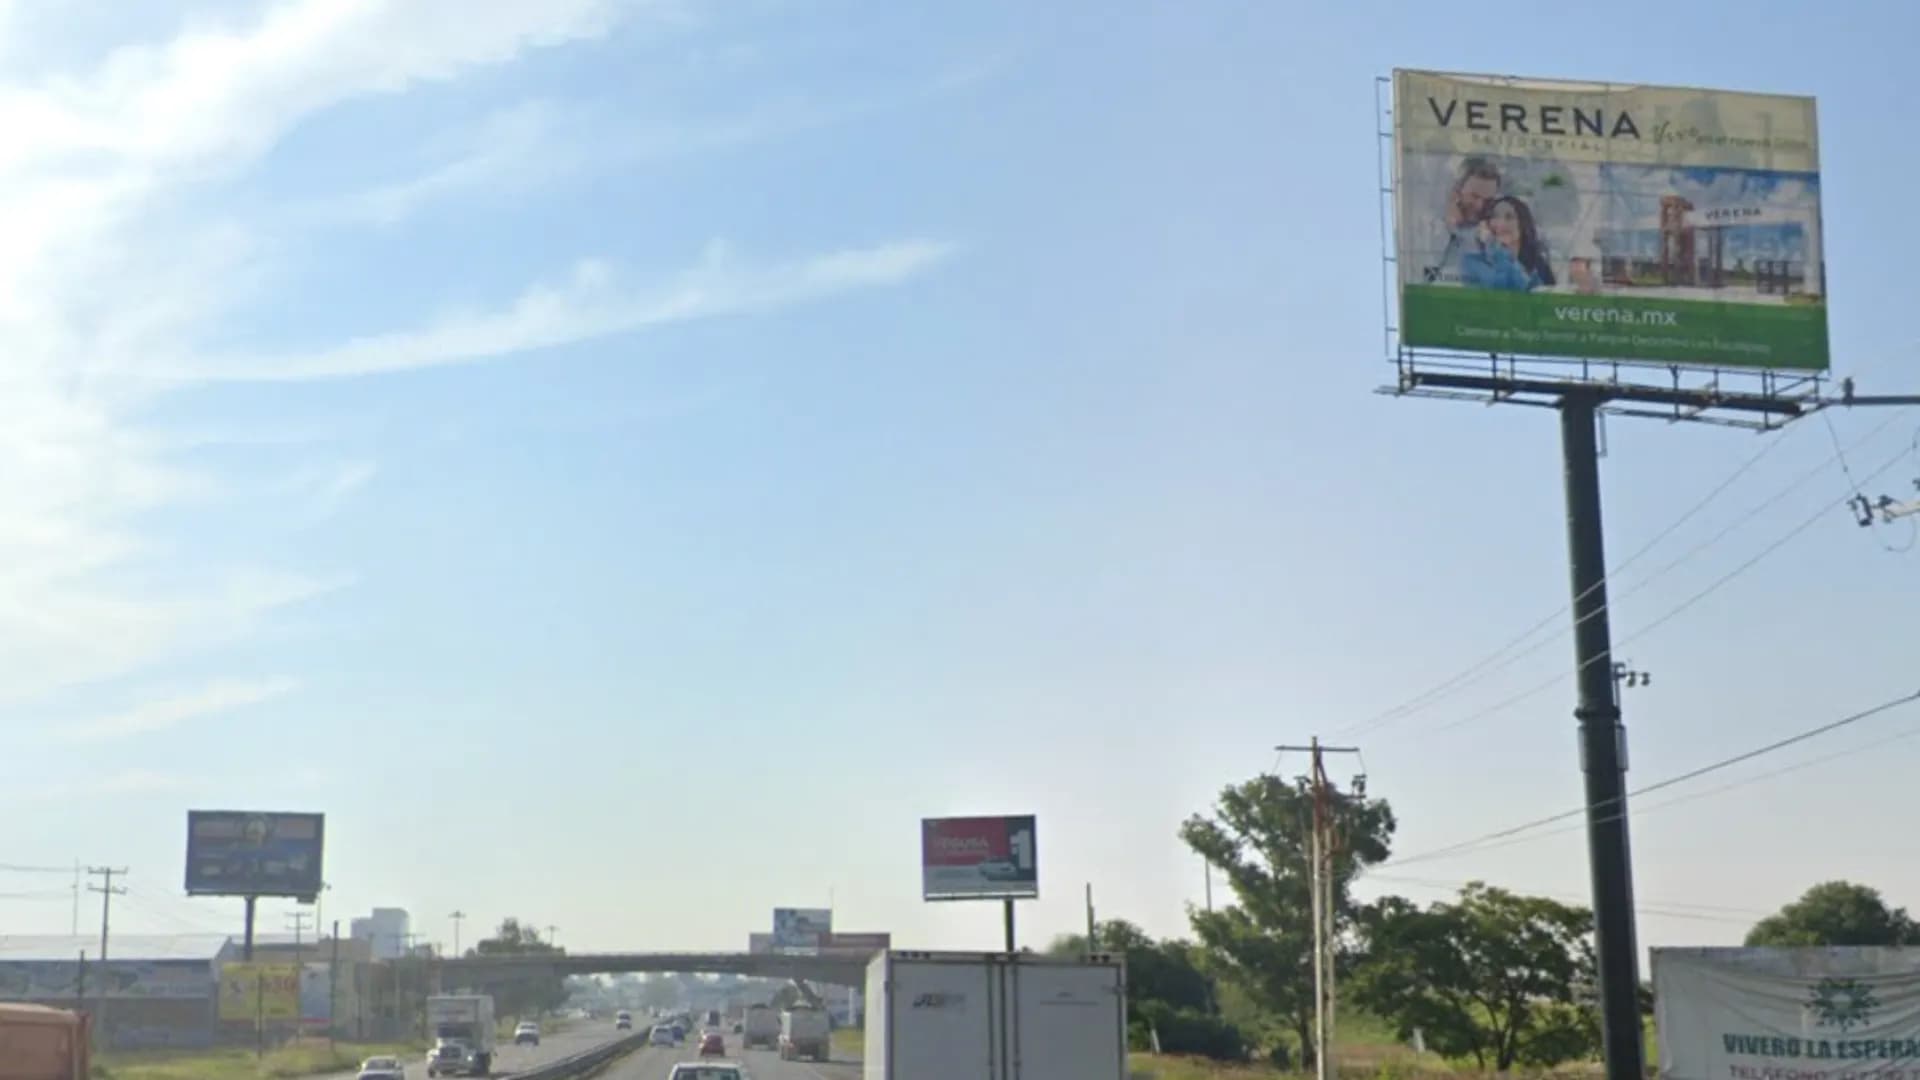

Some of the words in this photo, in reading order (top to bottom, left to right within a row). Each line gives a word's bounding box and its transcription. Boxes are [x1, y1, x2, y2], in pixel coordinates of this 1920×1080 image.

[1428, 96, 1640, 139] VERENA
[1553, 304, 1678, 326] verena.mx
[1723, 1034, 1801, 1058] VIVERO
[1806, 1039, 1832, 1059] LA
